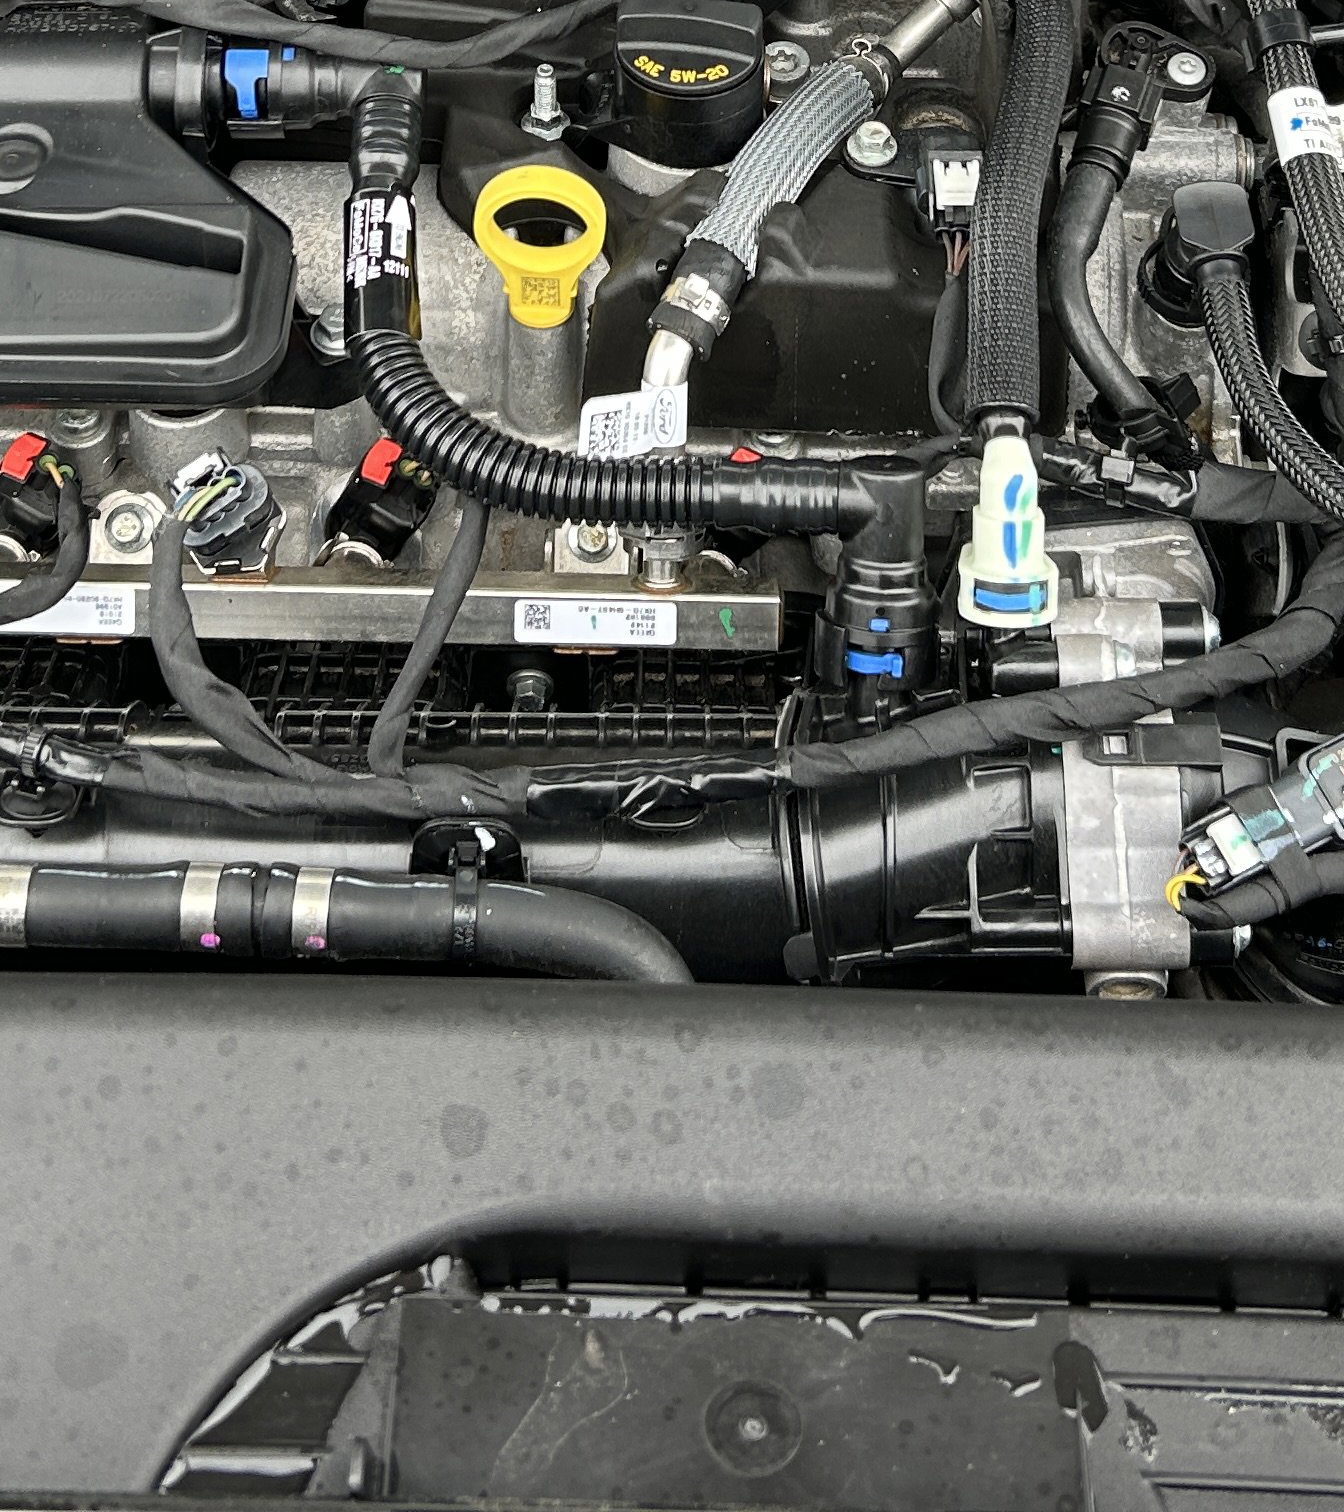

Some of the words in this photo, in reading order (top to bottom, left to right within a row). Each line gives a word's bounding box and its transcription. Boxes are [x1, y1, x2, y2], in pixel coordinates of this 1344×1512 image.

[633, 55, 665, 78] SAE
[669, 64, 730, 84] 5W-20
[352, 200, 365, 252] FoMoCo
[659, 397, 671, 435] Ford
